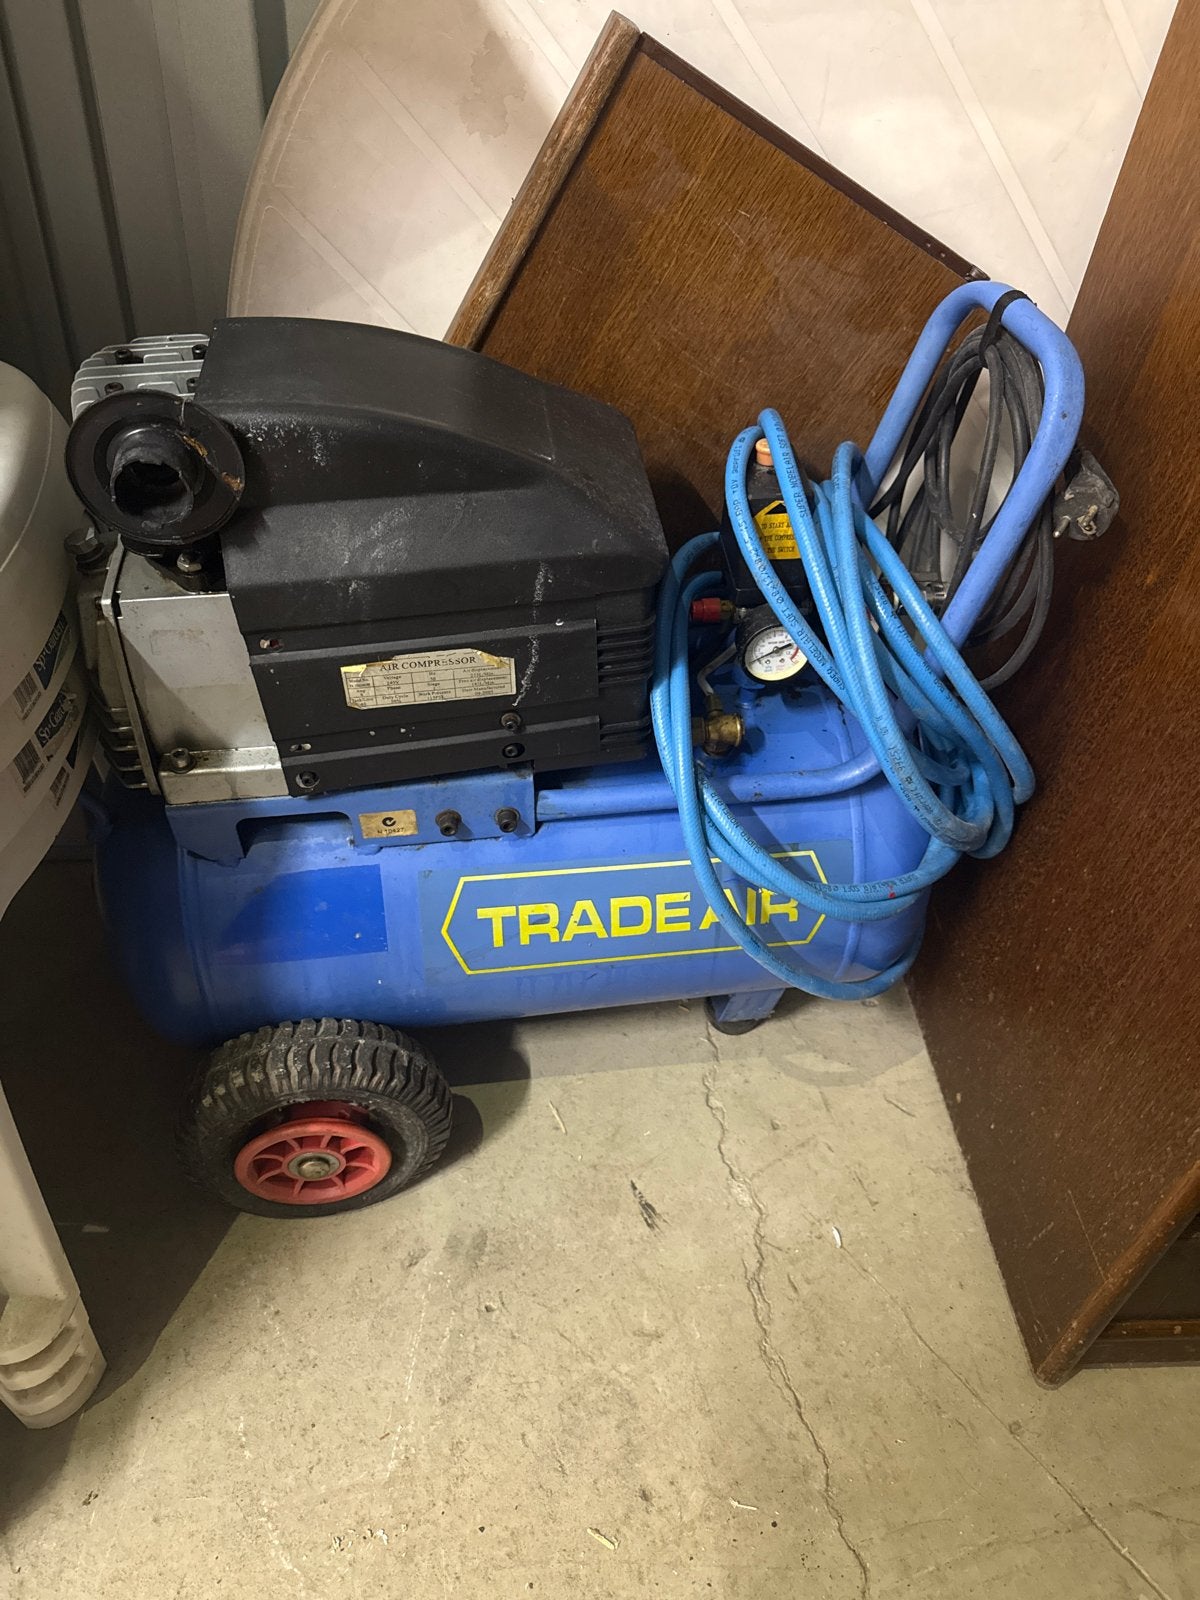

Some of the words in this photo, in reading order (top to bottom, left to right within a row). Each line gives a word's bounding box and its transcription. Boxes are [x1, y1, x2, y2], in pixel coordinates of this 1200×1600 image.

[793, 493, 808, 519] SUPER
[782, 607, 799, 627] SOFT
[379, 663, 399, 673] AIR
[401, 655, 477, 671] COMPRESSOR
